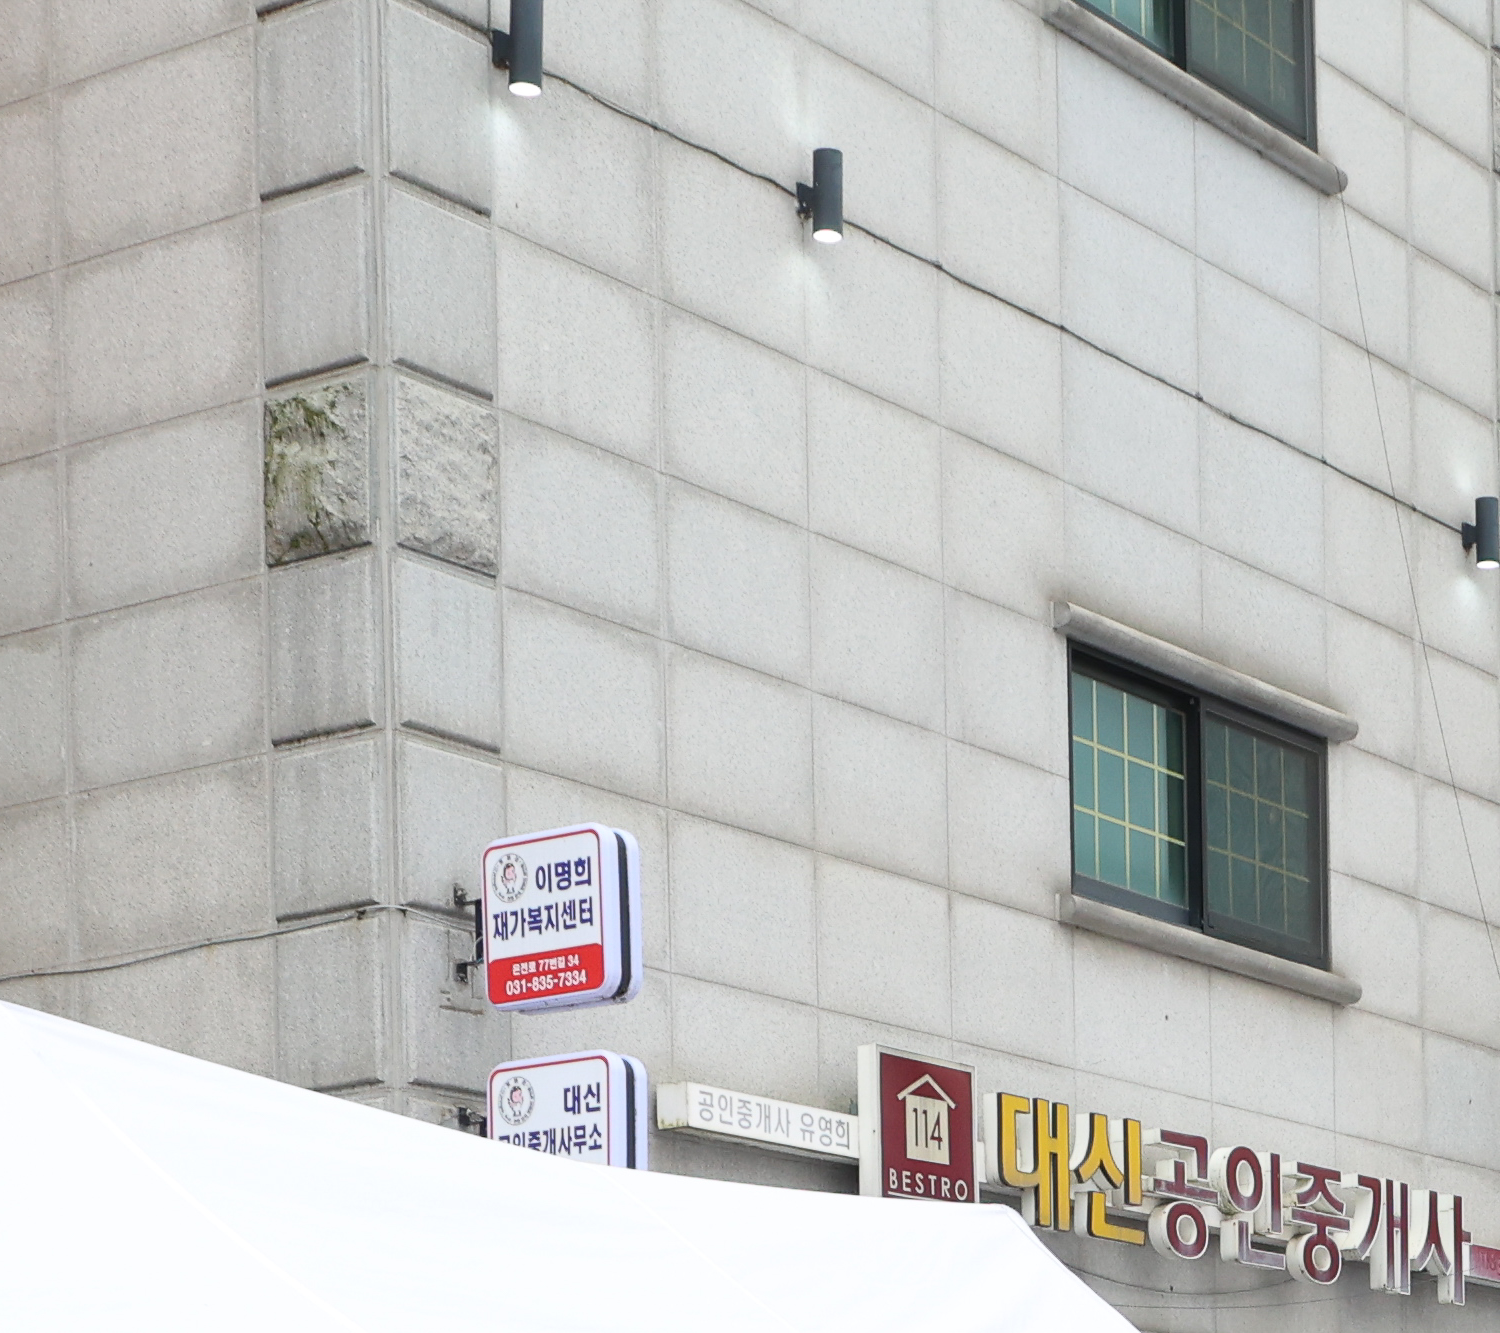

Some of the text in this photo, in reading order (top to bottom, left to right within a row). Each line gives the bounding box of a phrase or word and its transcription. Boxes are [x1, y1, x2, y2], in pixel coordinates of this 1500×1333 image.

[535, 856, 592, 893] 이명희
[492, 897, 594, 941] 재가복지센터
[567, 954, 580, 967] 34
[505, 969, 587, 996] 031-835-7334
[563, 1083, 602, 1117] 대신
[697, 1089, 851, 1151] 공인중개사 유영희
[911, 1106, 944, 1151] 114
[888, 1167, 970, 1201] BESTRO
